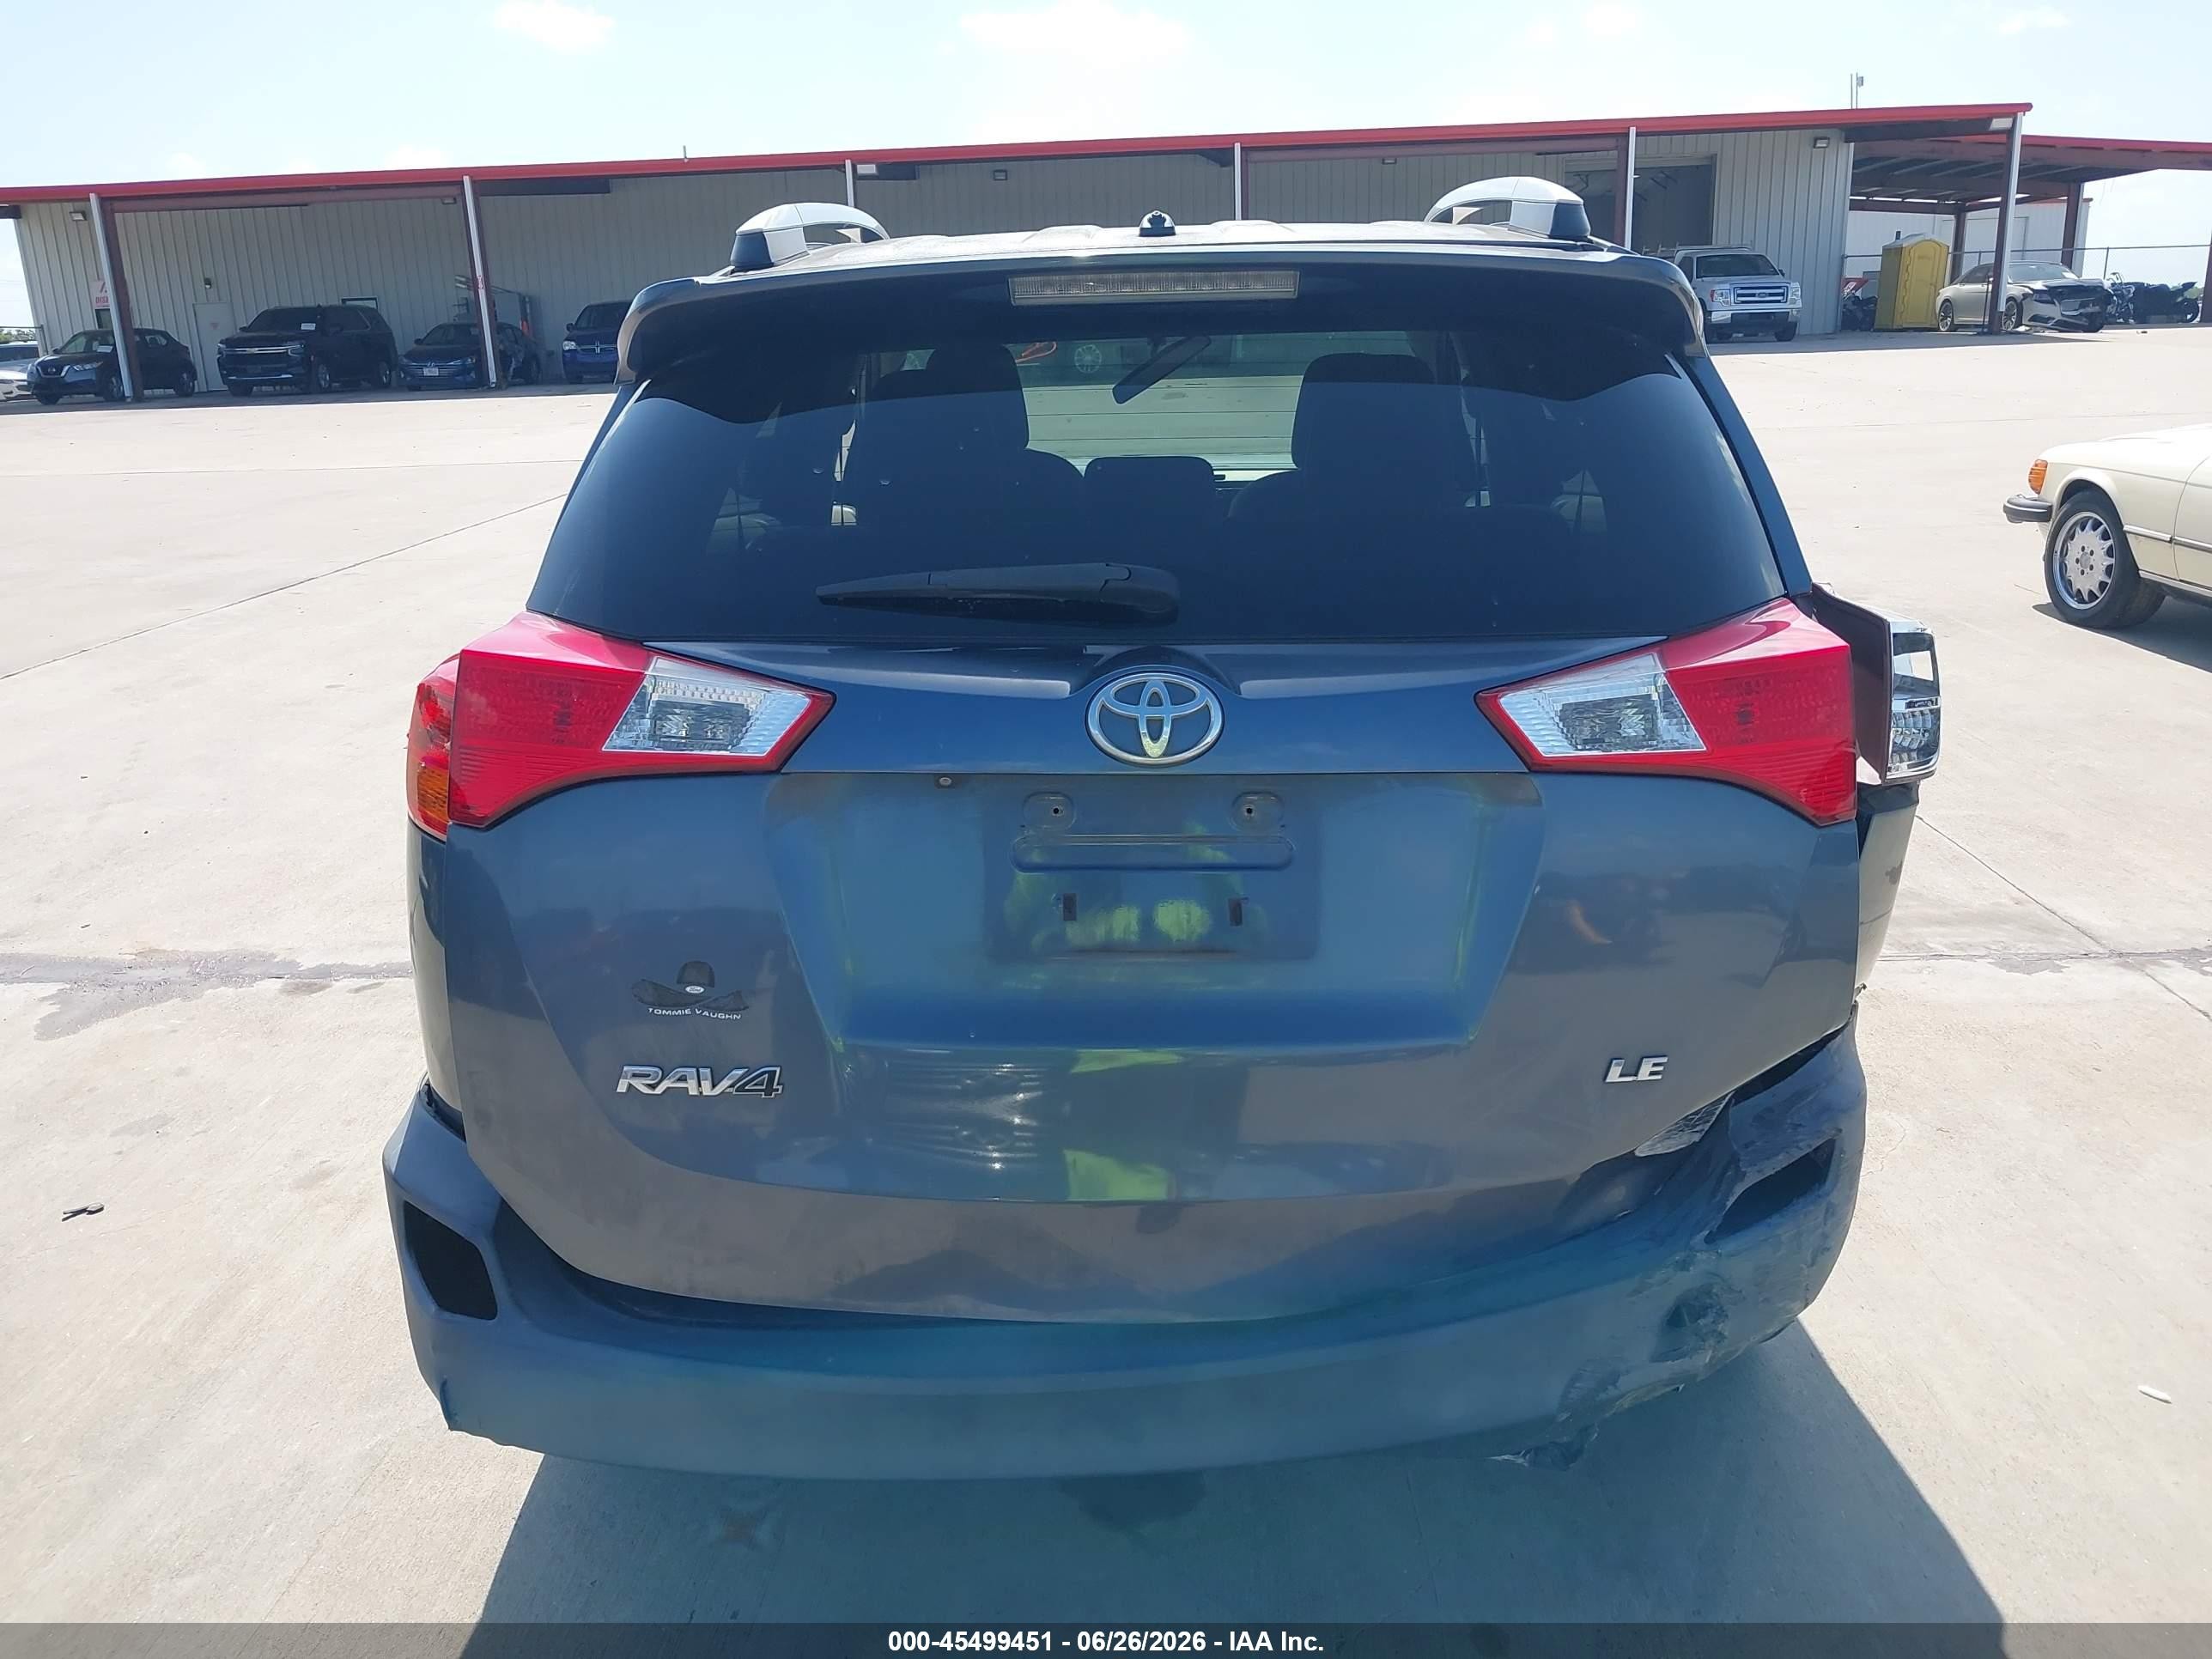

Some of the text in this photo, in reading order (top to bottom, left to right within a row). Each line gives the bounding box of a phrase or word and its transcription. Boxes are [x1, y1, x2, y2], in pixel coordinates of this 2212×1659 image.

[648, 1007, 741, 1019] TOMMIE VAUGHN
[617, 1066, 782, 1098] RAV4
[1604, 1056, 1668, 1082] LE
